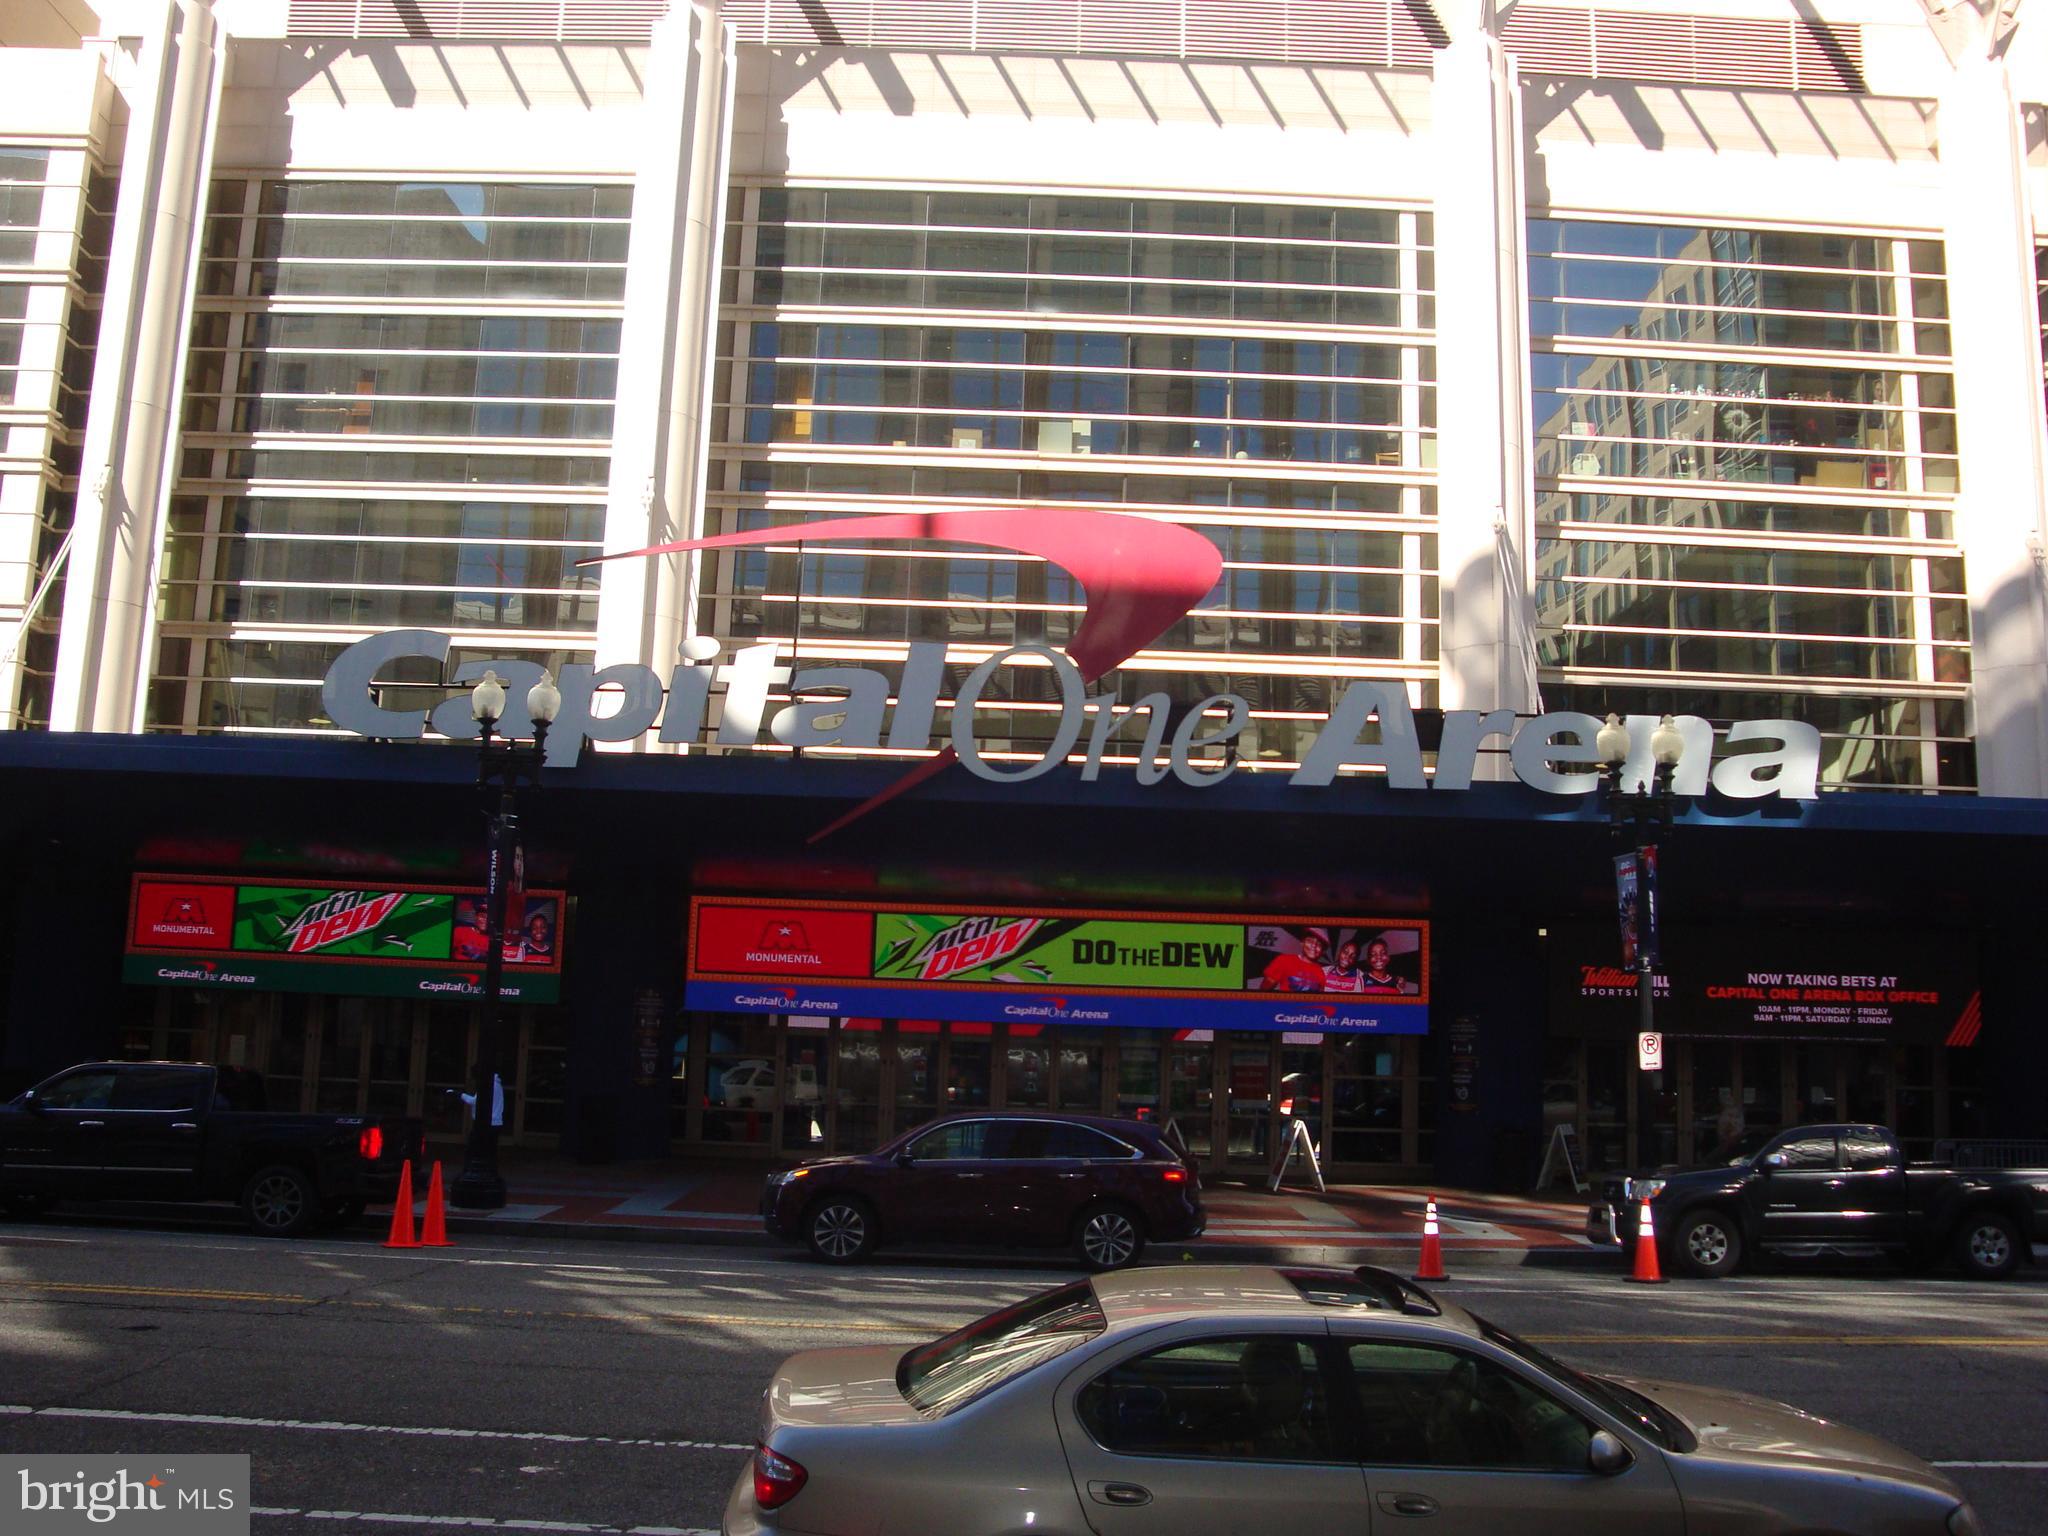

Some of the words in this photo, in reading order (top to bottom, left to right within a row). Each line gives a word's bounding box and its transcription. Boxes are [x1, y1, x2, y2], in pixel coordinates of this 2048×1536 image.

[1288, 681, 1821, 799] Arena
[490, 849, 498, 895] WILSON
[152, 923, 215, 935] MONUMENTAL
[745, 952, 822, 965] MONUMENTAL
[219, 973, 257, 983] Arena
[1748, 973, 1783, 985] NOW
[1786, 974, 1838, 986] TAKING
[1841, 975, 1876, 987] BETS
[1879, 976, 1897, 988] AT
[1581, 988, 1670, 997] SPORTSOK
[1706, 986, 1766, 999] CAPITAL
[1769, 988, 1799, 1000] ONE
[1803, 989, 1850, 1002] ARENA
[1856, 990, 1885, 1003] BOX
[1888, 991, 1939, 1004] OFFICE
[800, 1000, 838, 1010] Arena
[1758, 1005, 1781, 1013] 10AM
[1813, 1007, 1851, 1015] MONDAY
[1858, 1008, 1888, 1016] FRIDAY
[1070, 1009, 1109, 1019] Arena
[1754, 1014, 1773, 1022] 9AM
[1806, 1015, 1850, 1023] SATURDAY
[1857, 1016, 1892, 1025] SUNDAY
[1339, 1018, 1378, 1027] Arena
